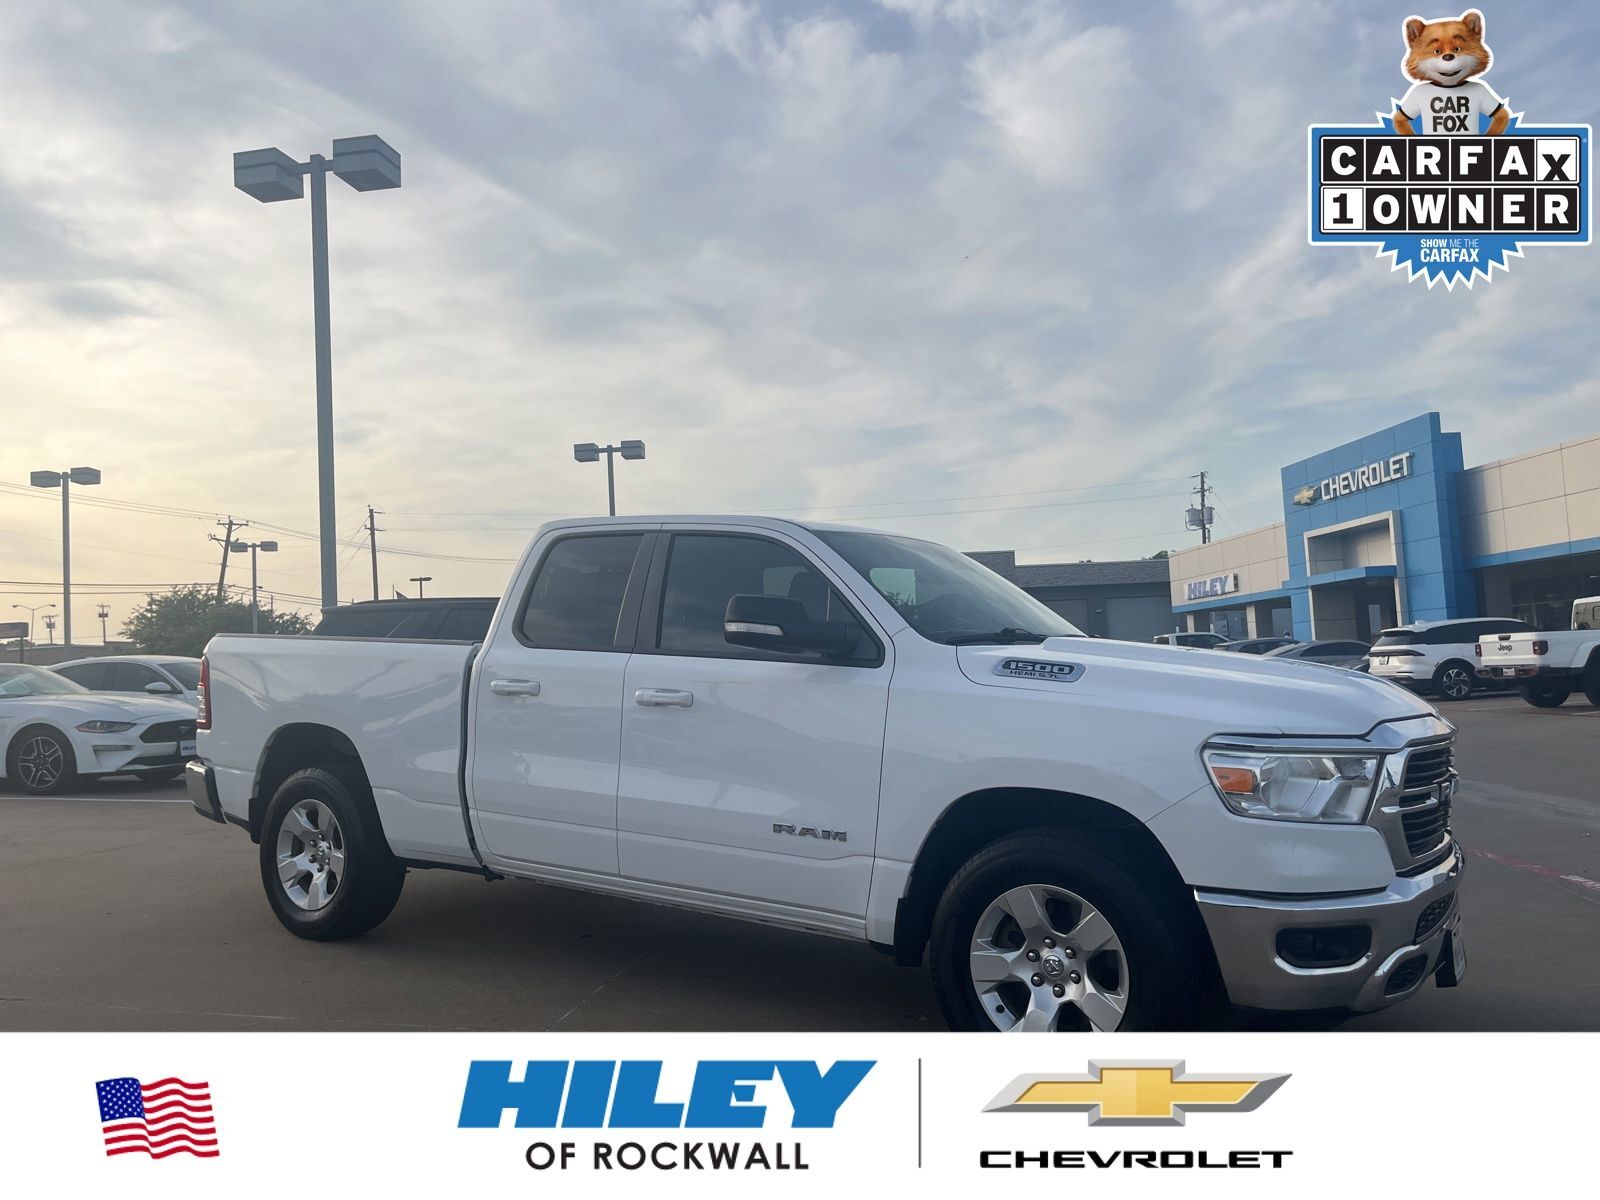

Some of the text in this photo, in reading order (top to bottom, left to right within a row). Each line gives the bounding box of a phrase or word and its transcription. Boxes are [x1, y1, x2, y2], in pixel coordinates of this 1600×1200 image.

[1320, 451, 1411, 501] CHEVROLET
[1187, 574, 1229, 600] HILEY
[1497, 643, 1513, 652] Jeep
[1009, 661, 1070, 674] 1500
[772, 822, 848, 842] RAM
